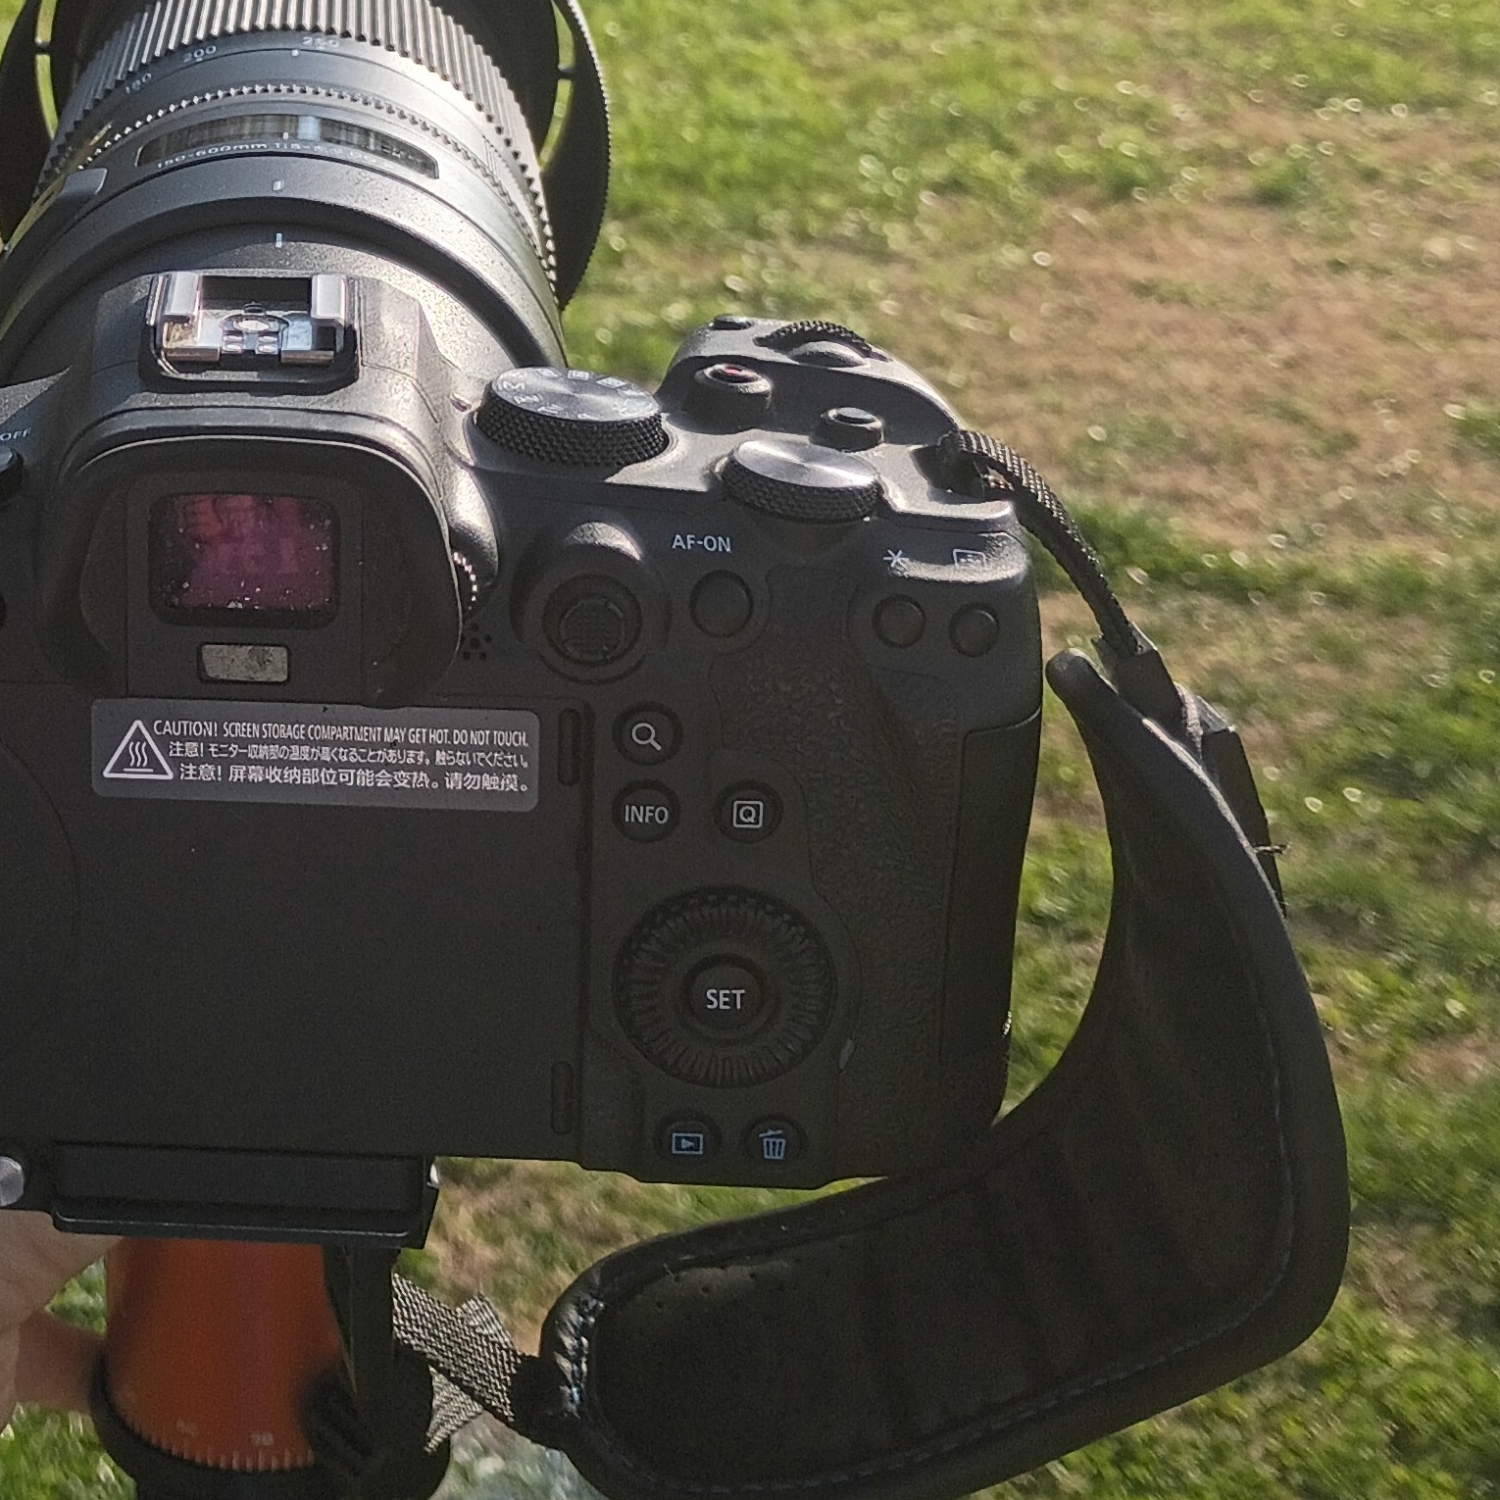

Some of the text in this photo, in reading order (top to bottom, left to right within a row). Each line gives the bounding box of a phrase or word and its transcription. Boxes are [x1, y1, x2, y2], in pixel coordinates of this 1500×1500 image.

[182, 45, 217, 62] 200
[0, 428, 32, 442] OFF
[671, 533, 732, 553] AF-ON
[152, 719, 529, 747] CAUTION! SCREEN STORAGE COMPARTMENT MAY GET HOT. DO NOT TOUCH.
[624, 804, 669, 825] INFO
[738, 805, 757, 824] Q
[706, 988, 746, 1010] SET
